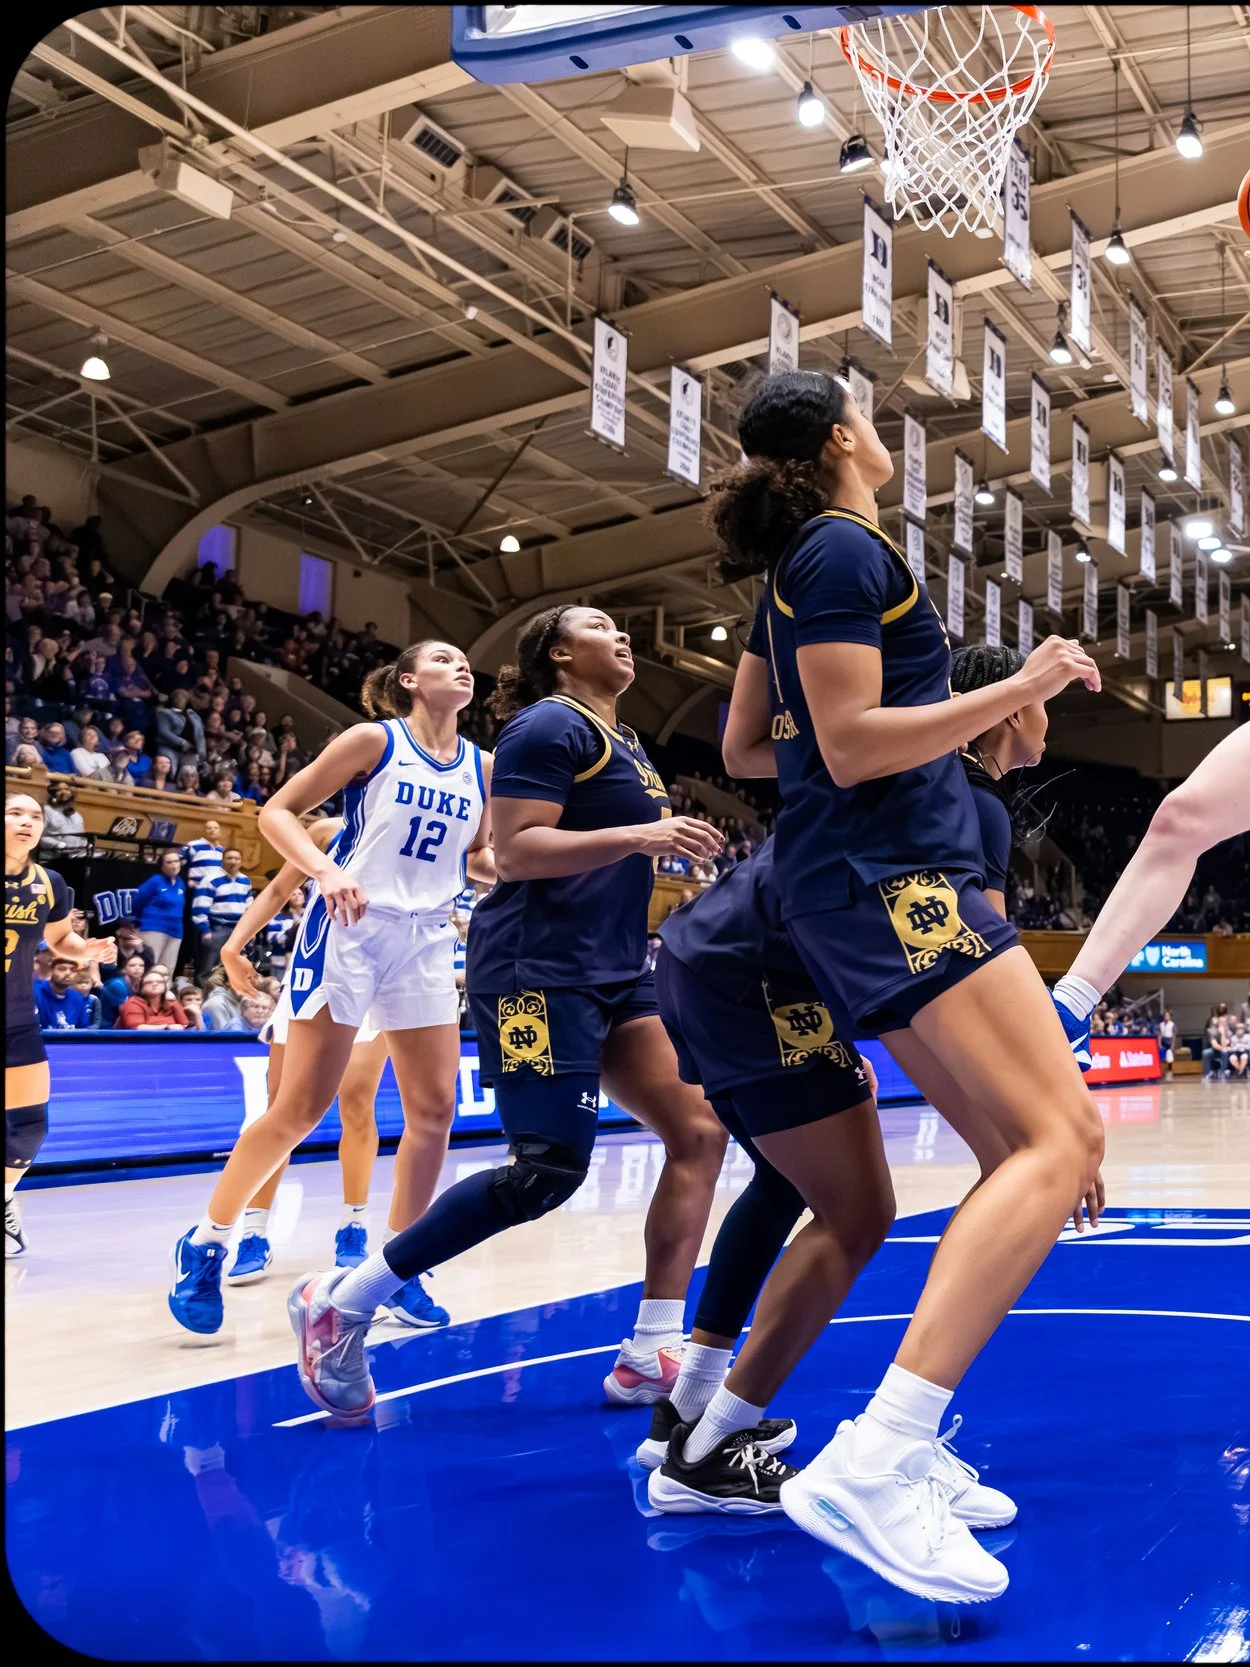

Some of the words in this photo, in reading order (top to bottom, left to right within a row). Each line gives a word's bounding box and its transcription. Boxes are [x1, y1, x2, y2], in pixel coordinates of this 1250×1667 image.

[395, 781, 471, 821] DUKE
[399, 815, 447, 863] 12
[5, 896, 38, 920] ish
[1161, 946, 1191, 958] North
[1161, 956, 1204, 968] Carolina
[291, 967, 312, 992] D
